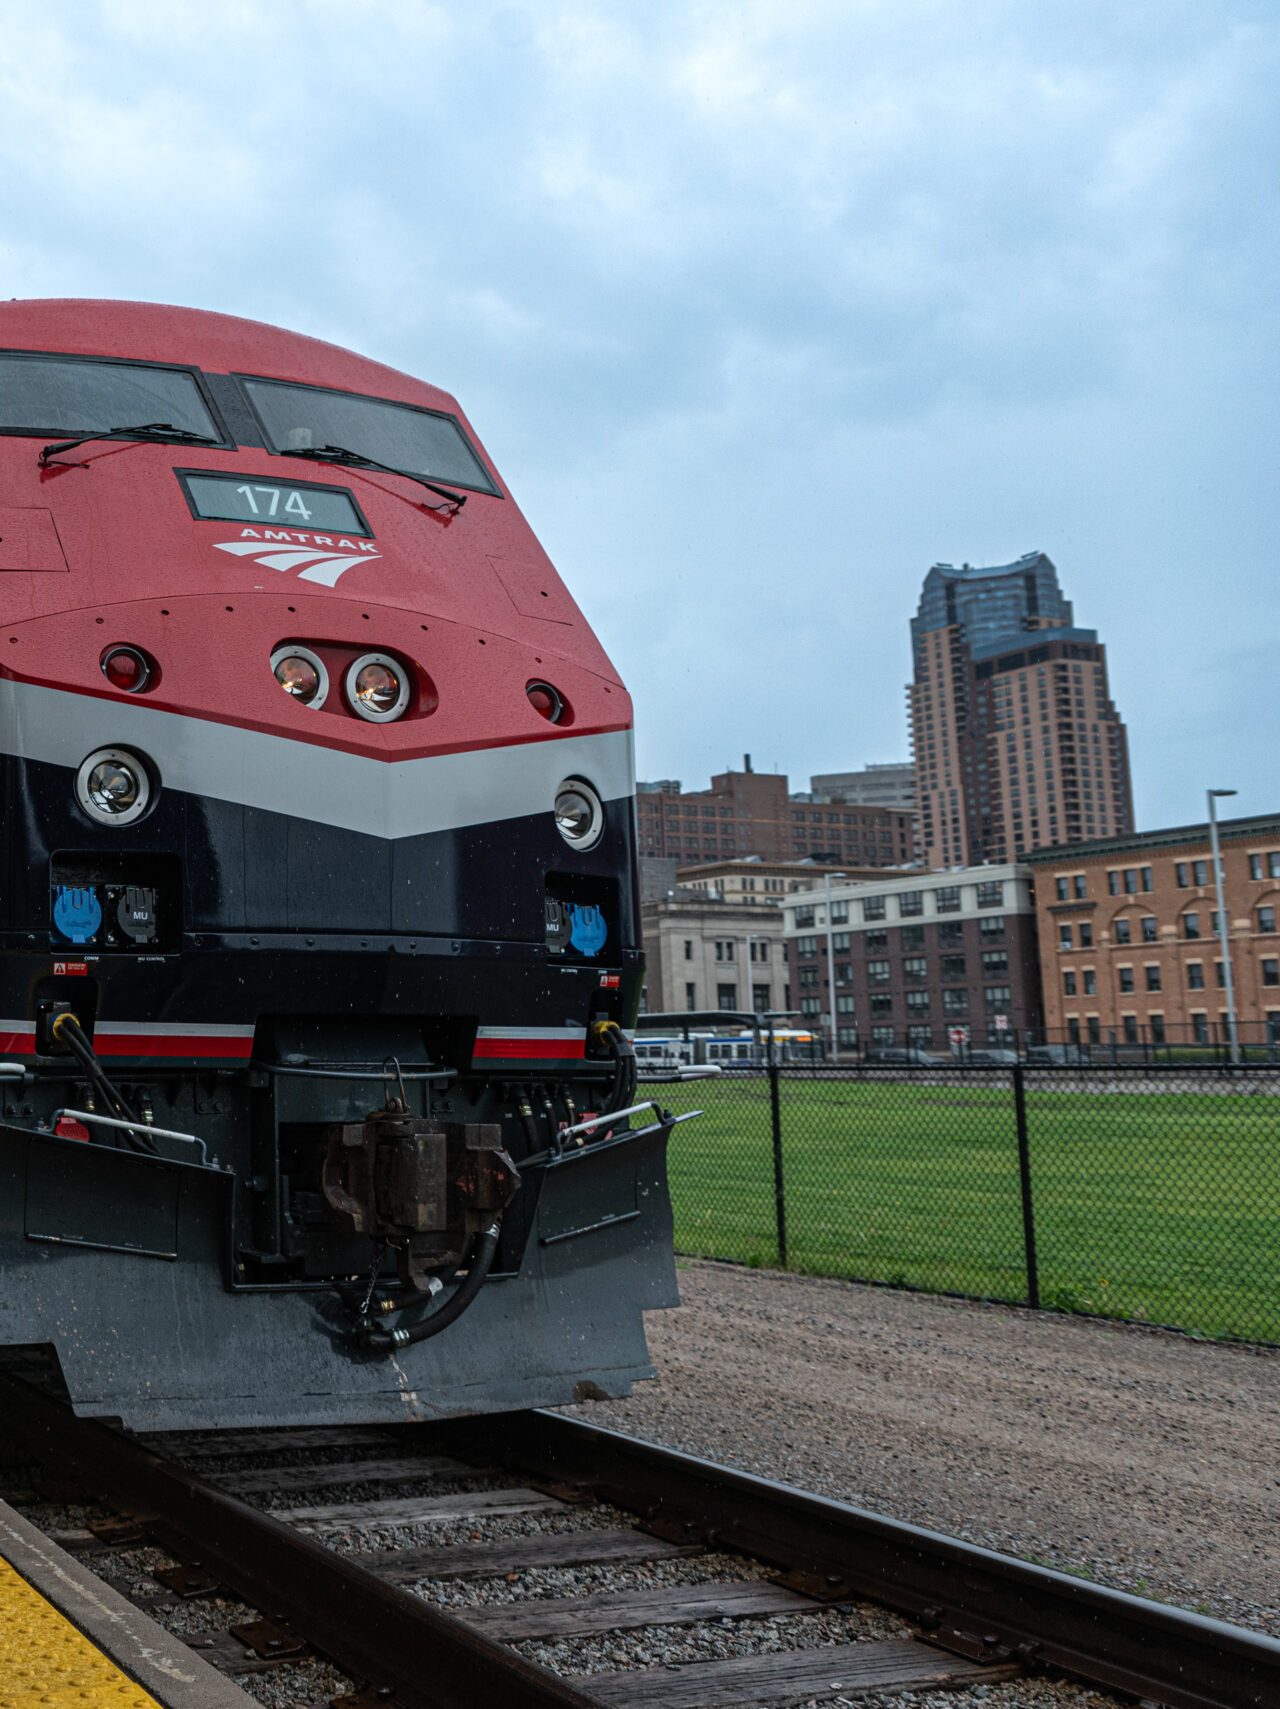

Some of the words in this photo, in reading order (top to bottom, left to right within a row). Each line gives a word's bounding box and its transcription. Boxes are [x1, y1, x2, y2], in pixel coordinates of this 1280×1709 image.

[236, 485, 312, 520] 174
[240, 528, 378, 553] AMTRAK
[133, 911, 148, 920] MU
[546, 924, 559, 932] MU
